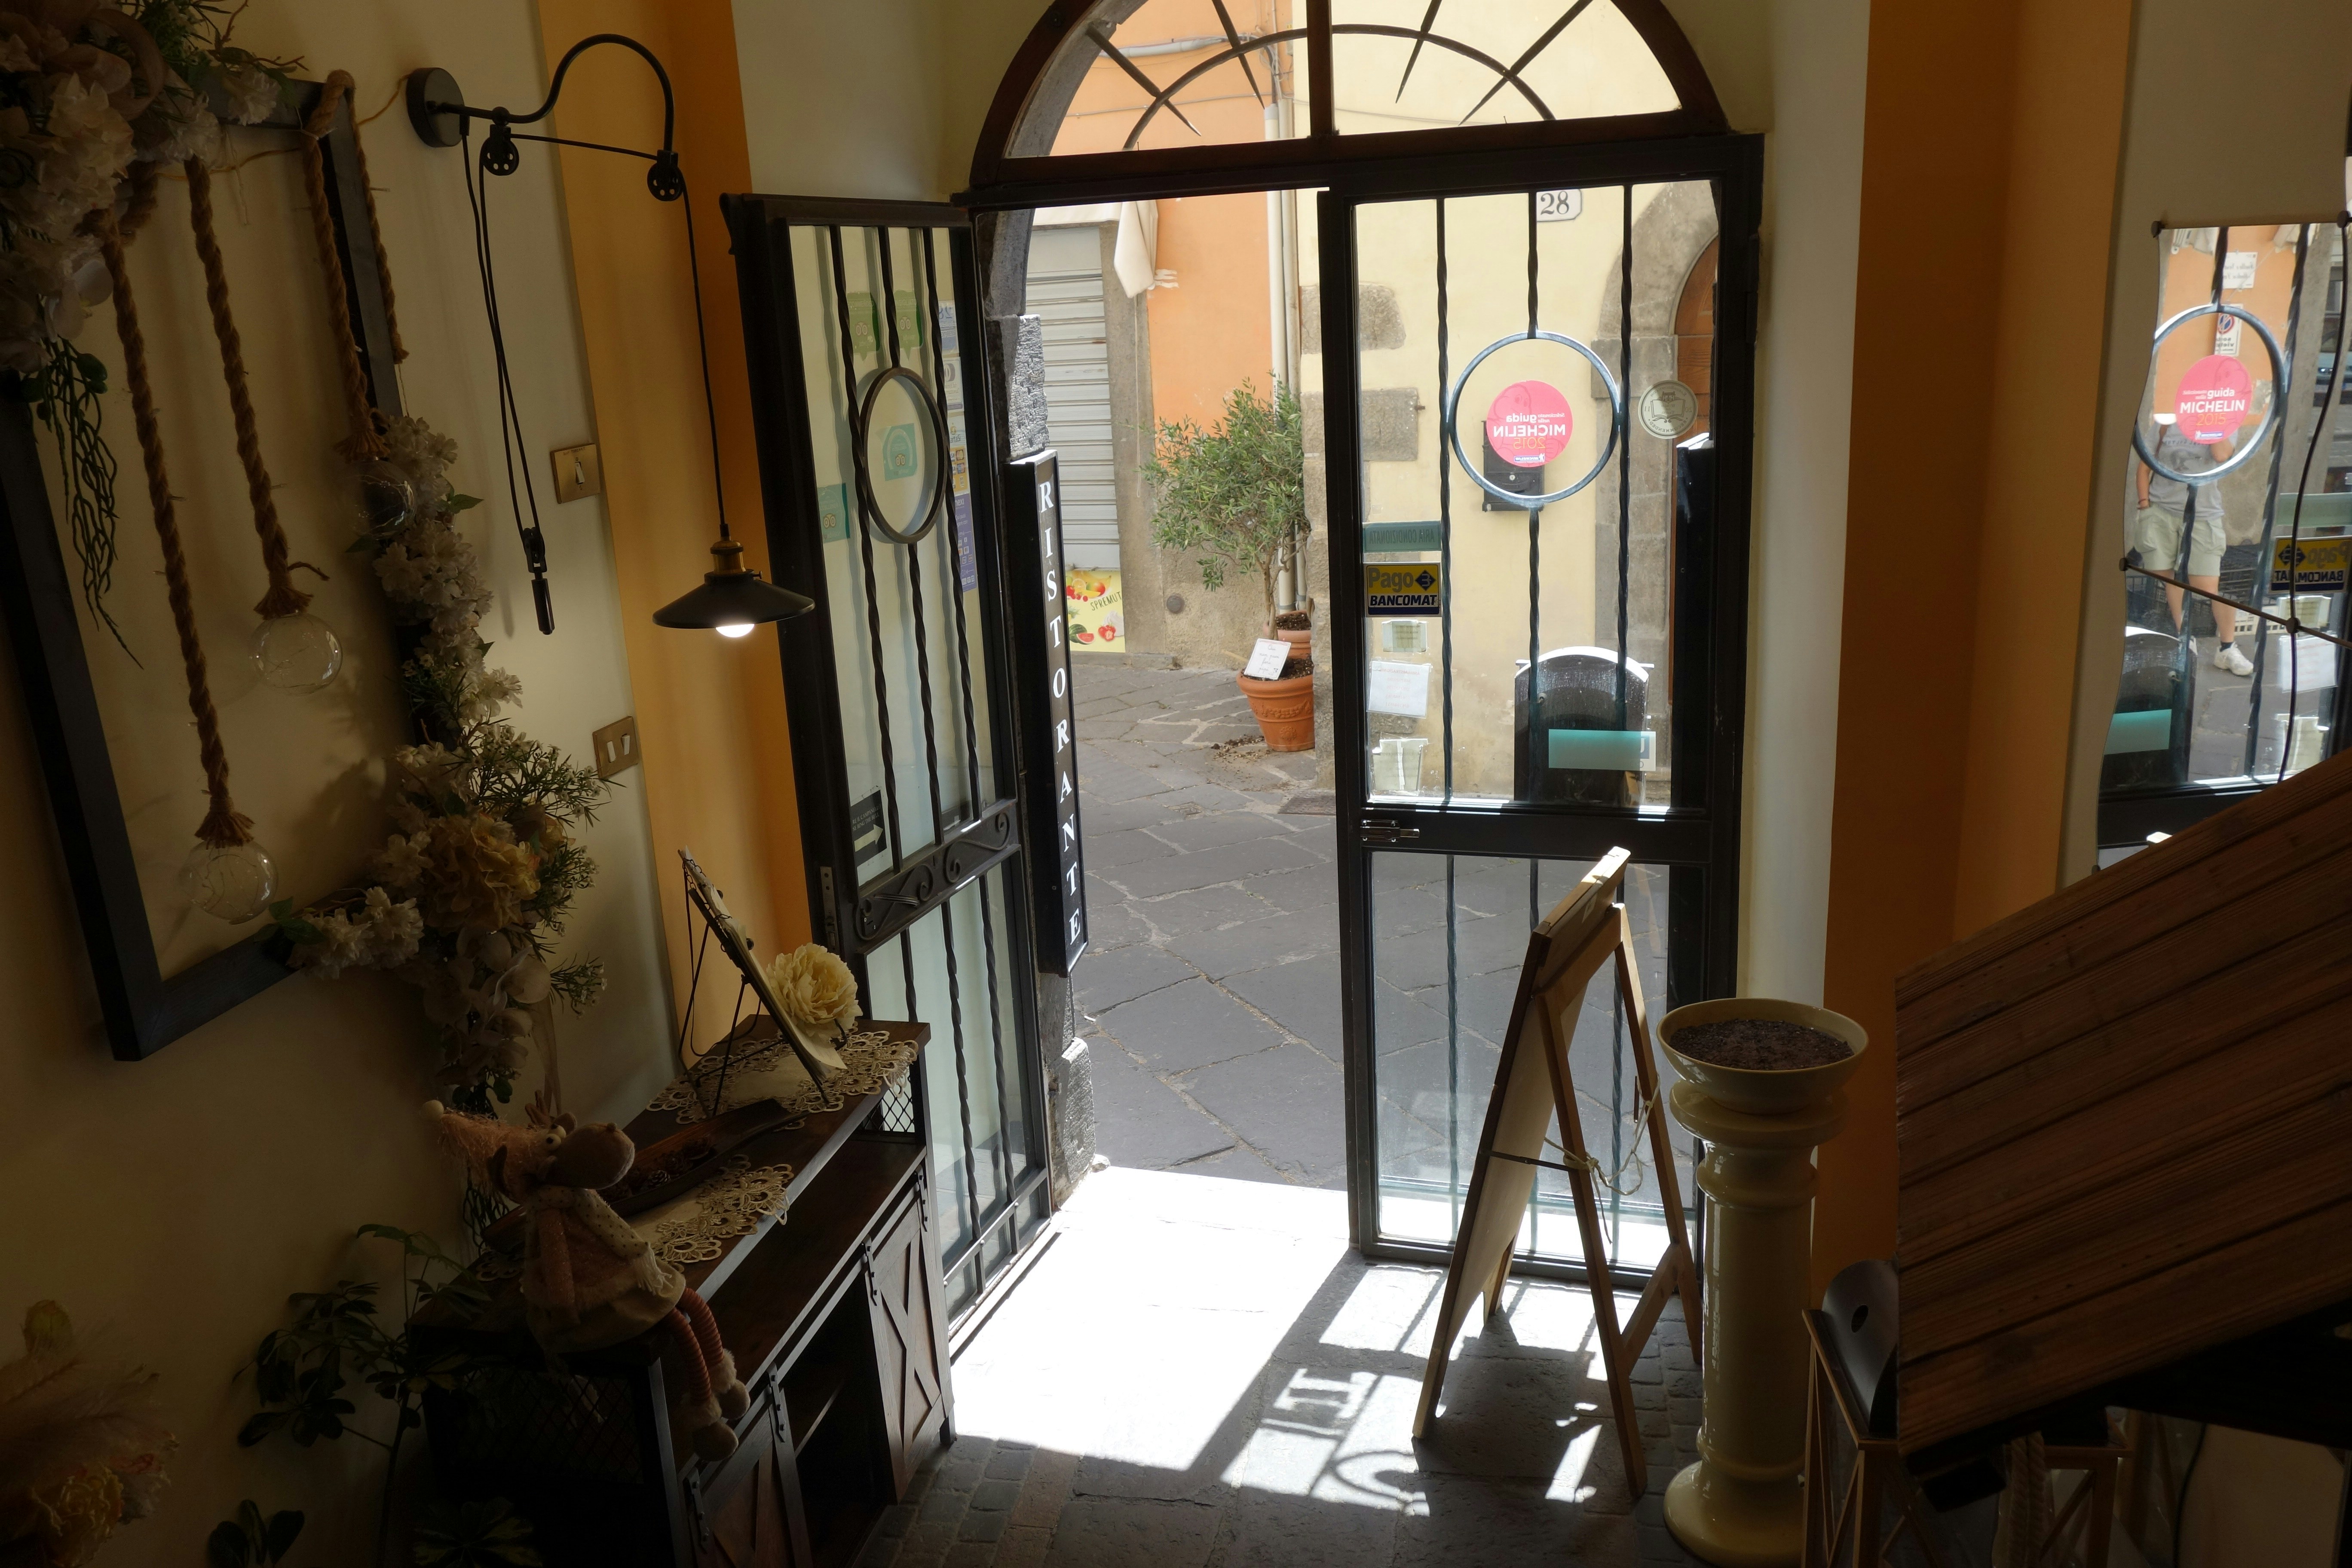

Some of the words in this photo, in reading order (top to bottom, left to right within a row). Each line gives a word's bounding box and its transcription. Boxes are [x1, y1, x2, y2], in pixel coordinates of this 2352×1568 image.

[1540, 190, 1569, 215] 28
[2207, 387, 2235, 399] guida
[2180, 399, 2245, 414] MICHELIN
[2196, 413, 2226, 426] 2015
[1368, 567, 1414, 593] Pago
[1090, 591, 1122, 611] SPREMUT
[1370, 594, 1437, 606] BANCOMAT
[1039, 481, 1082, 946] RISTORANTE
